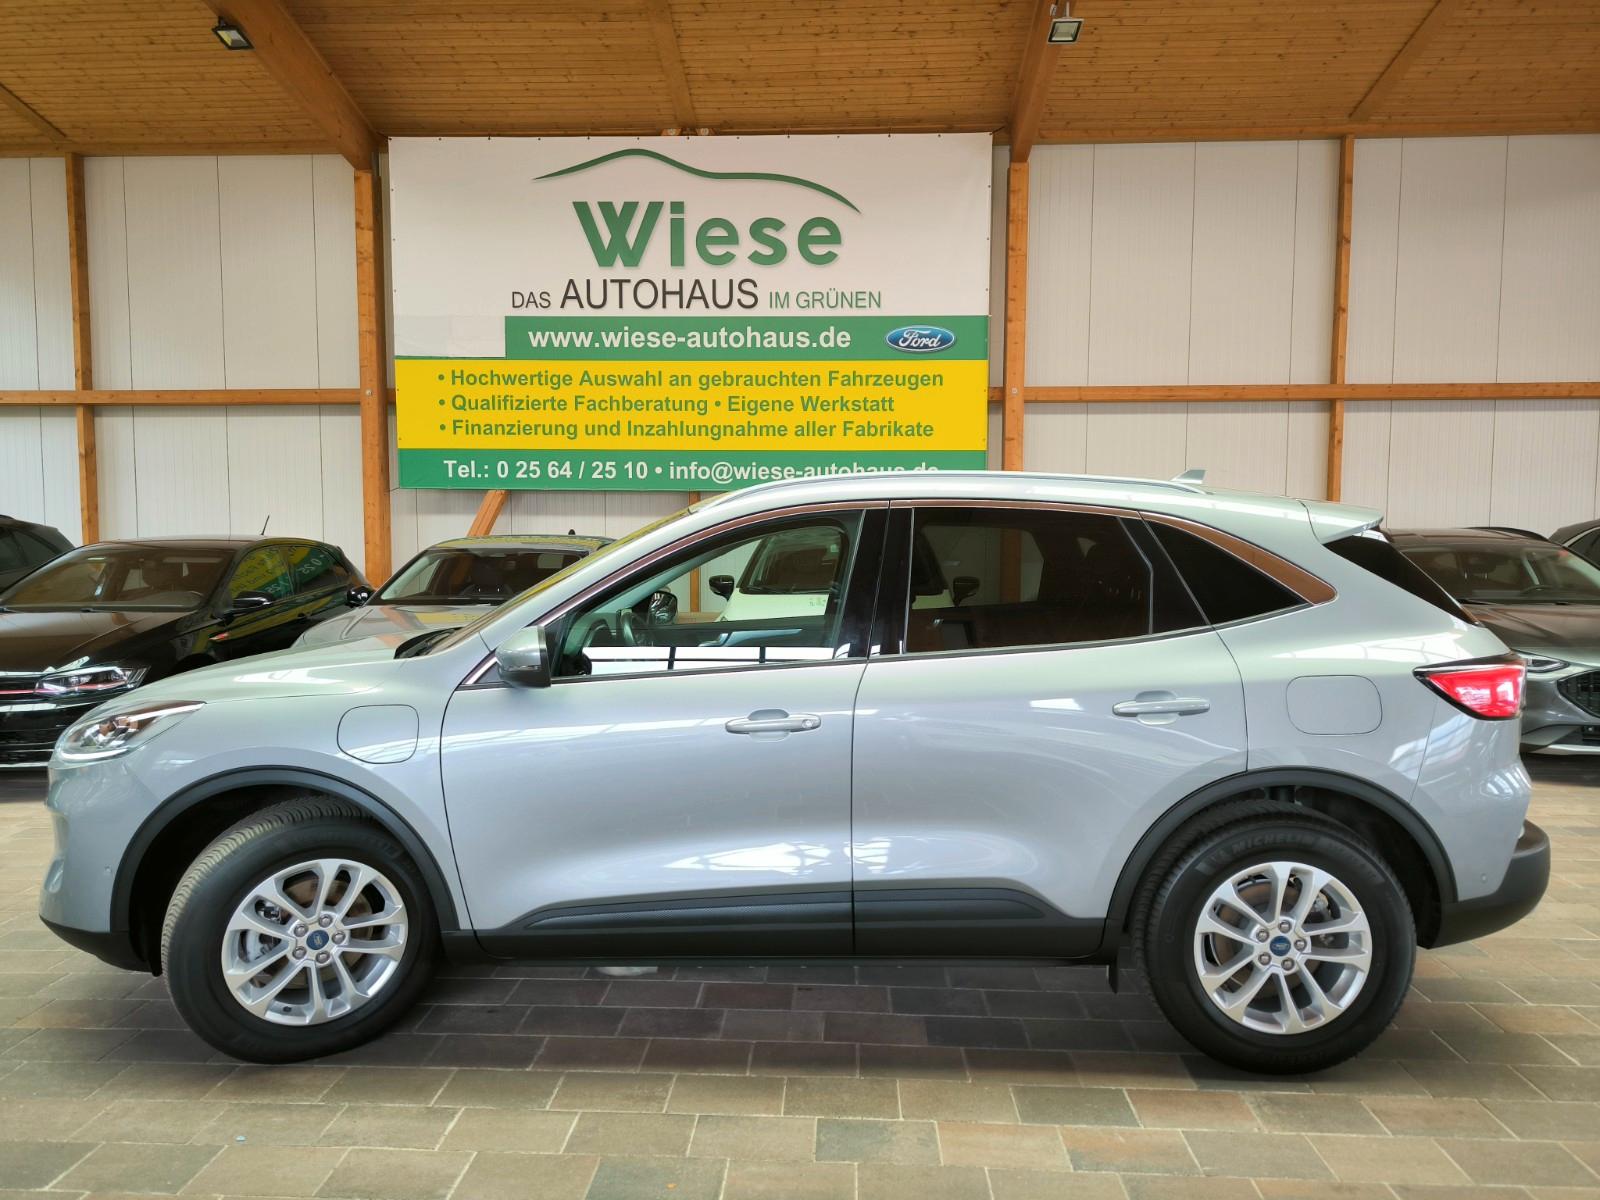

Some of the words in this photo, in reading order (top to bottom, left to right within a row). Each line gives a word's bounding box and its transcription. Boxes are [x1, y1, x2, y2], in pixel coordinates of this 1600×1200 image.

[572, 200, 843, 268] Wiese
[511, 291, 552, 309] DAS
[560, 278, 759, 310] AUTOHAUS
[769, 291, 790, 309] IM
[795, 287, 882, 309] GRÜNEN
[527, 326, 852, 349] www.wiese-autohaus.de
[898, 328, 942, 348] Ford
[451, 369, 573, 391] Hochwertige
[578, 369, 663, 388] Auswahl
[668, 374, 692, 388] an
[698, 370, 821, 391] gebrauchten
[828, 370, 944, 391] Fahrzeugen
[451, 394, 568, 412] Qualifizierte
[574, 394, 709, 417] Fachberatung
[727, 395, 795, 416] Eigene
[800, 395, 895, 413] Werkstatt
[452, 418, 578, 441] Finanzierung
[584, 419, 621, 437] und
[627, 419, 789, 441] Inzahlungnahme
[795, 420, 837, 437] aller
[842, 420, 934, 438] Fabrikate
[443, 460, 489, 478] Tel.:
[496, 460, 509, 479] 0
[515, 460, 541, 479] 25
[547, 460, 573, 479] 64
[591, 461, 617, 479] 25
[624, 461, 648, 480] 10
